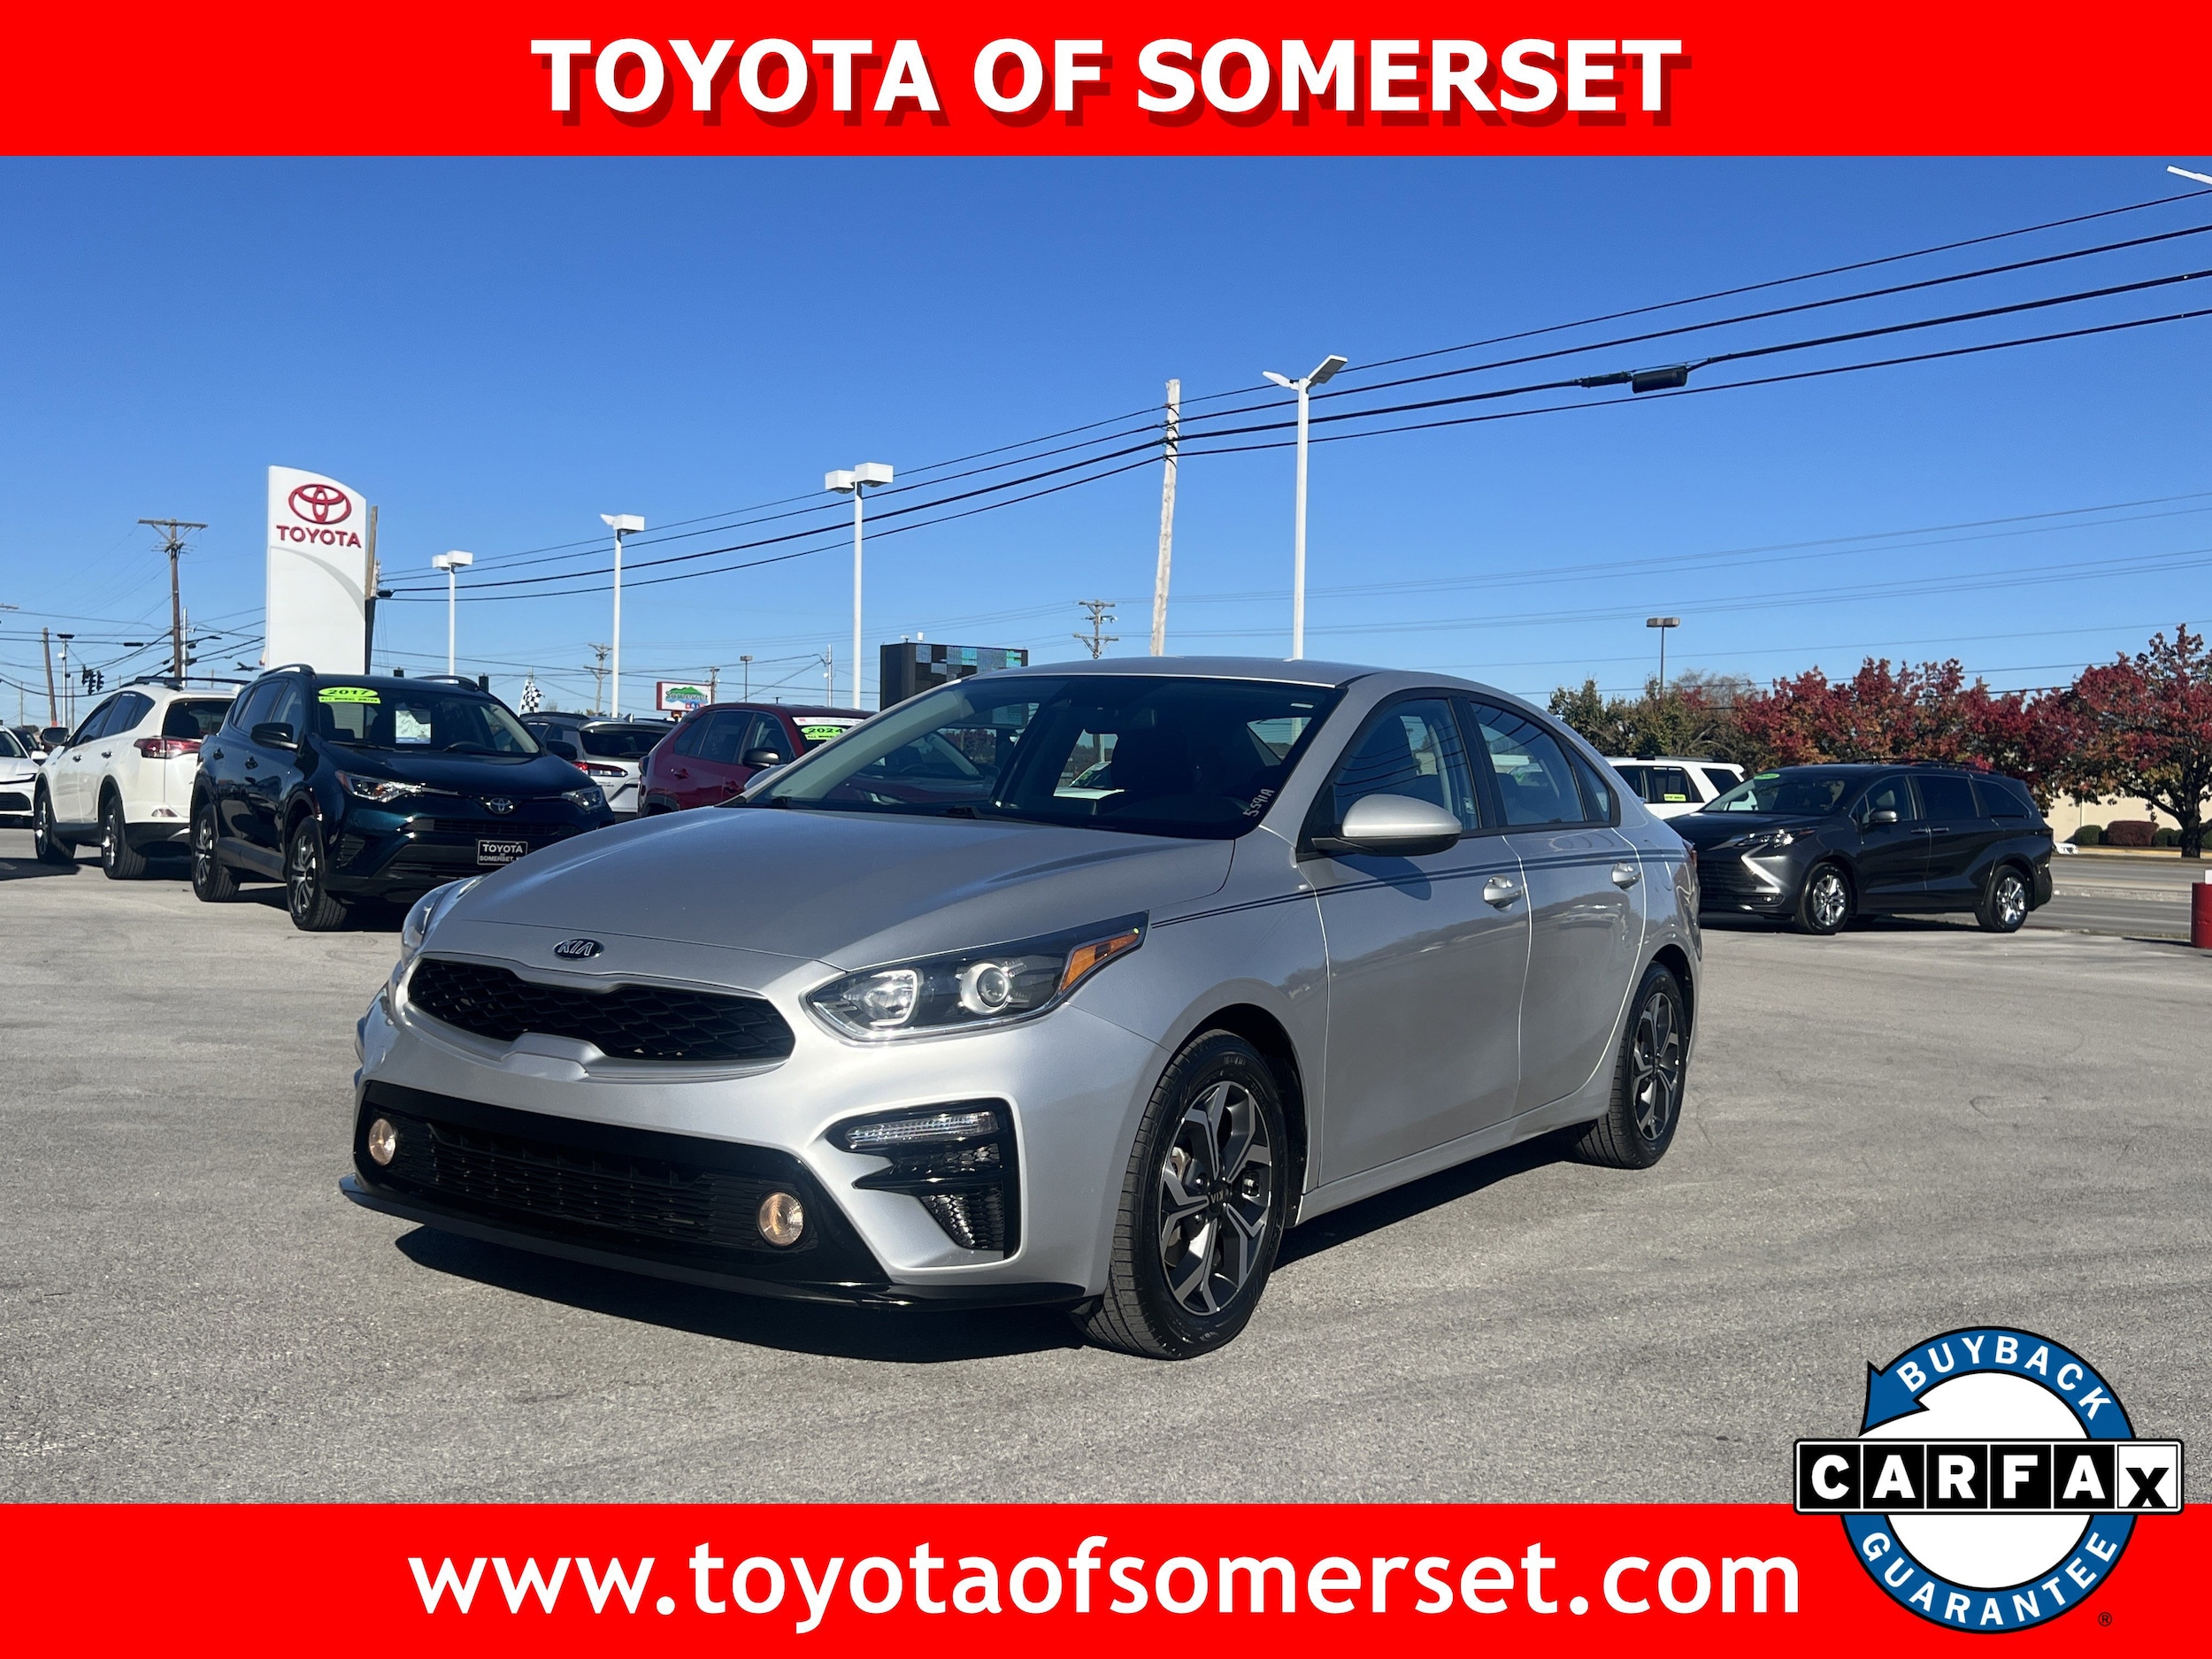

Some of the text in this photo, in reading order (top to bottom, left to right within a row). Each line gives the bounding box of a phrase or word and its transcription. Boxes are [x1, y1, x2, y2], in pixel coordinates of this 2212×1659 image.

[275, 525, 362, 549] TOYOTA
[1242, 788, 1275, 818] 5591A
[482, 843, 523, 854] TOYOTA
[557, 939, 595, 956] KIA
